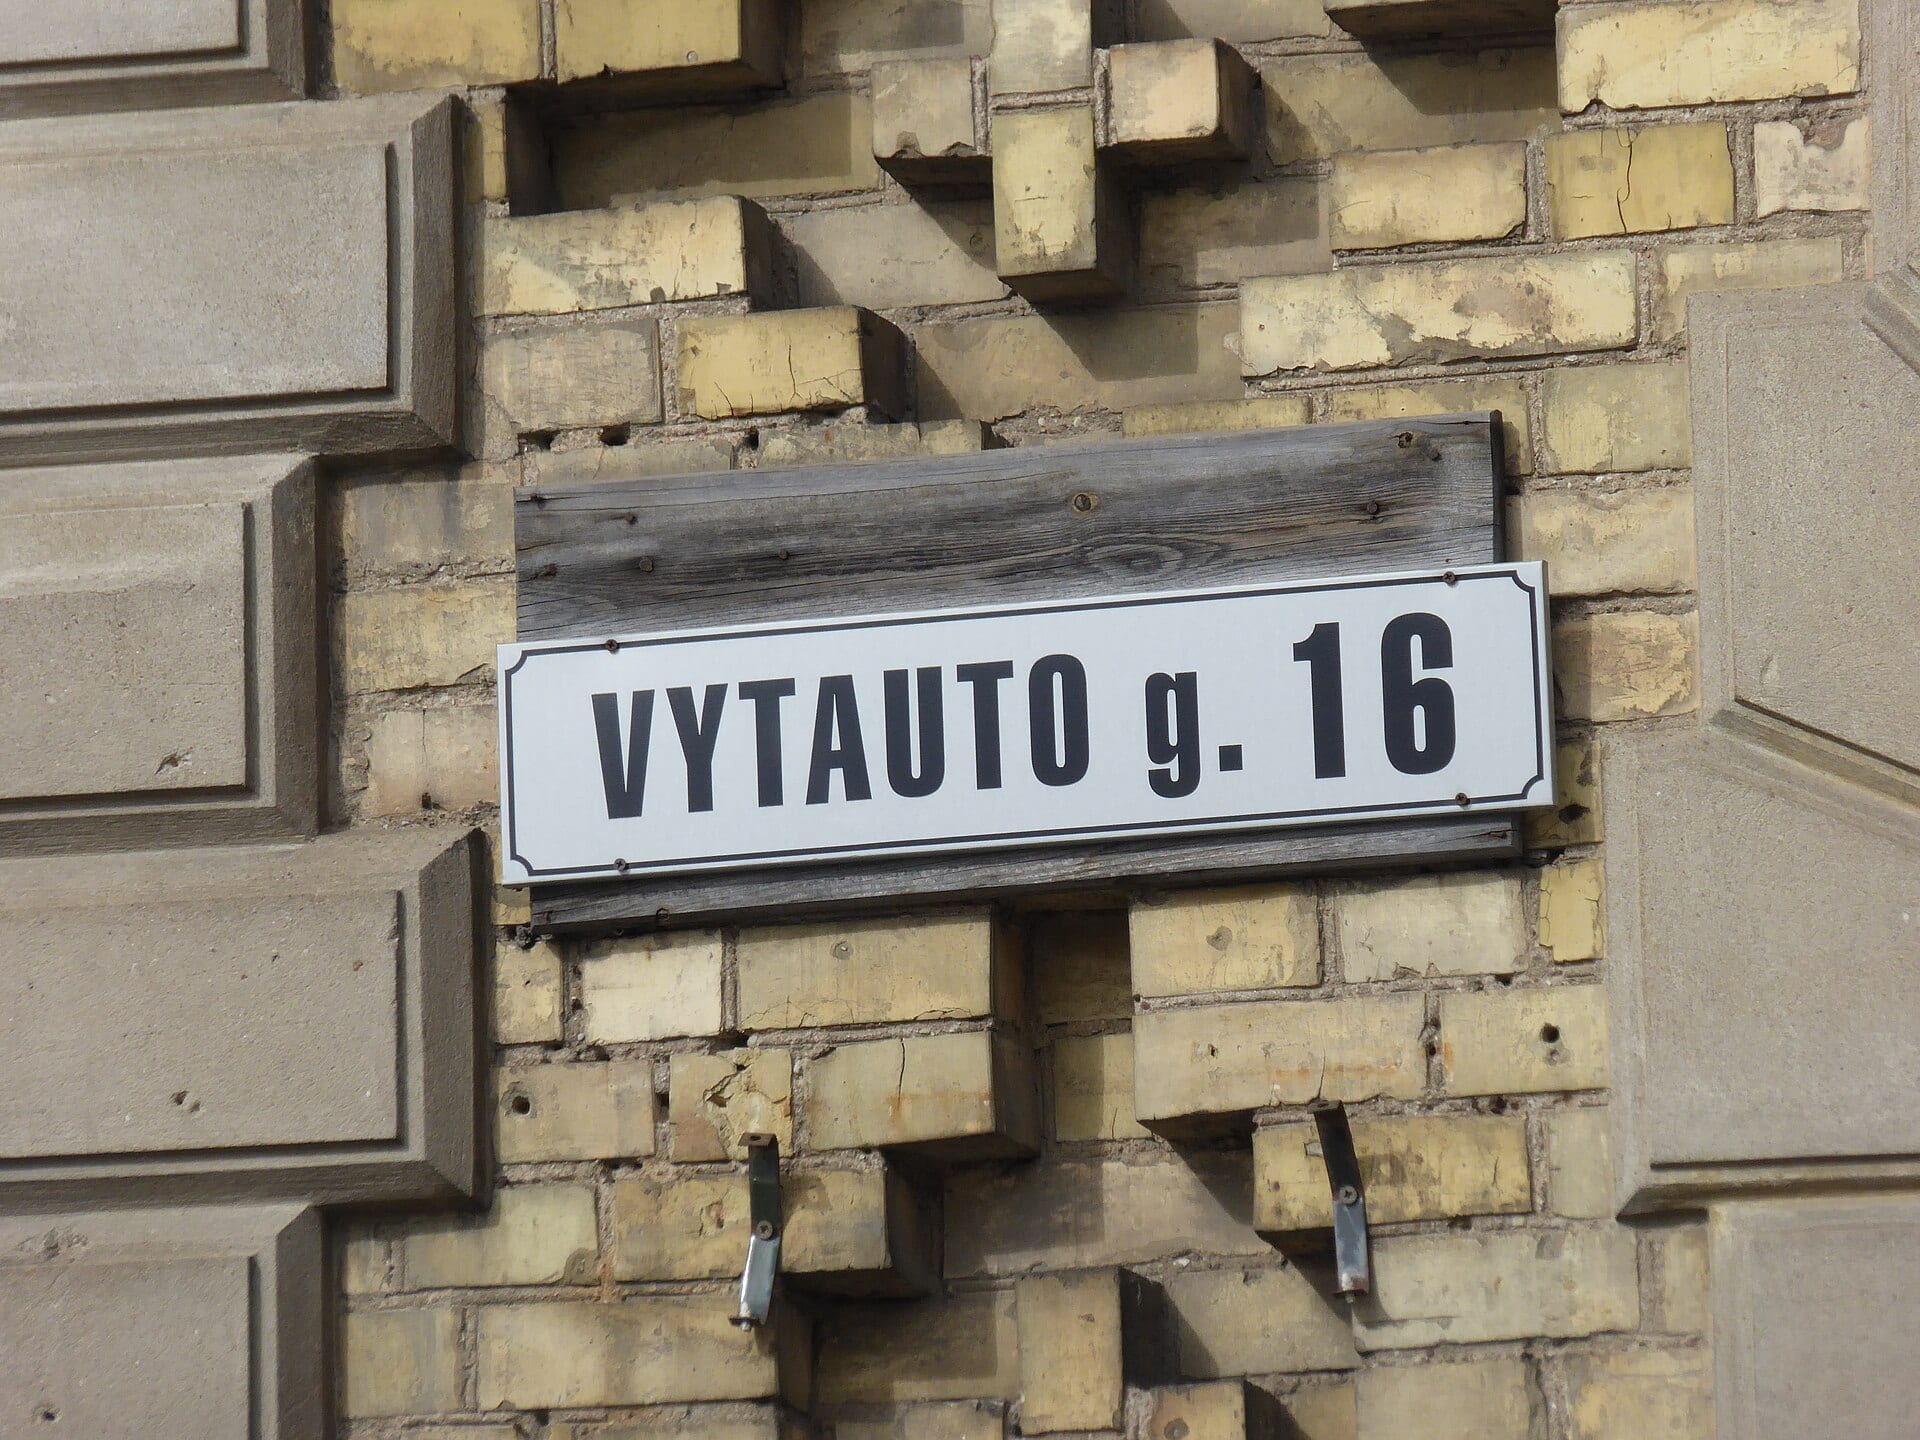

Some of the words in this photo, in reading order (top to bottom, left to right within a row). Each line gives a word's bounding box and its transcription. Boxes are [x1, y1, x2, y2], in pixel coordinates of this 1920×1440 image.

[591, 653, 1090, 820] VYTAUTO
[1144, 671, 1243, 799] g.
[1292, 612, 1456, 780] 16
